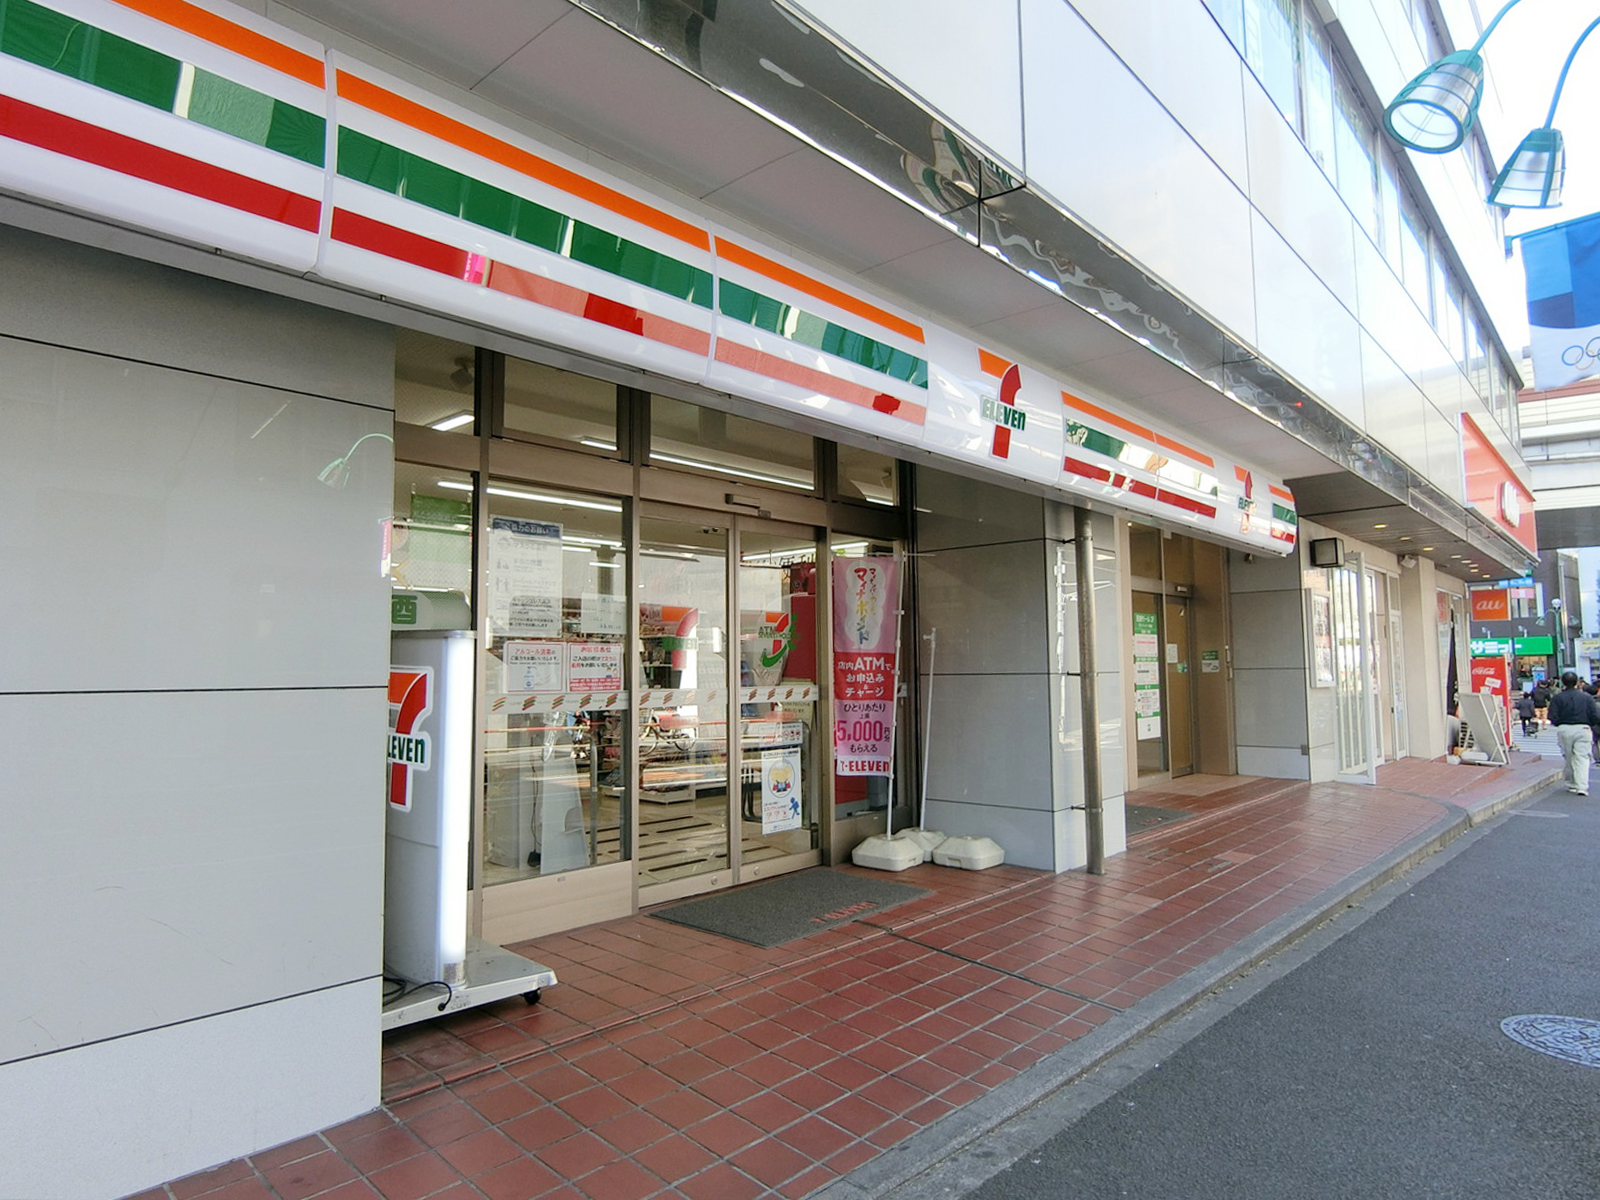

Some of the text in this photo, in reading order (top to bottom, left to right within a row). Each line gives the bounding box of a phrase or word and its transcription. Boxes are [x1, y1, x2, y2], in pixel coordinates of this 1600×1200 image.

[1476, 599, 1505, 611] au
[1470, 639, 1523, 655] サミット
[837, 656, 892, 671] 店内ATMで
[845, 673, 885, 684] お申込み
[845, 687, 885, 699] チャージ
[843, 703, 887, 713] ひとりあたり
[849, 743, 879, 753] もらえる
